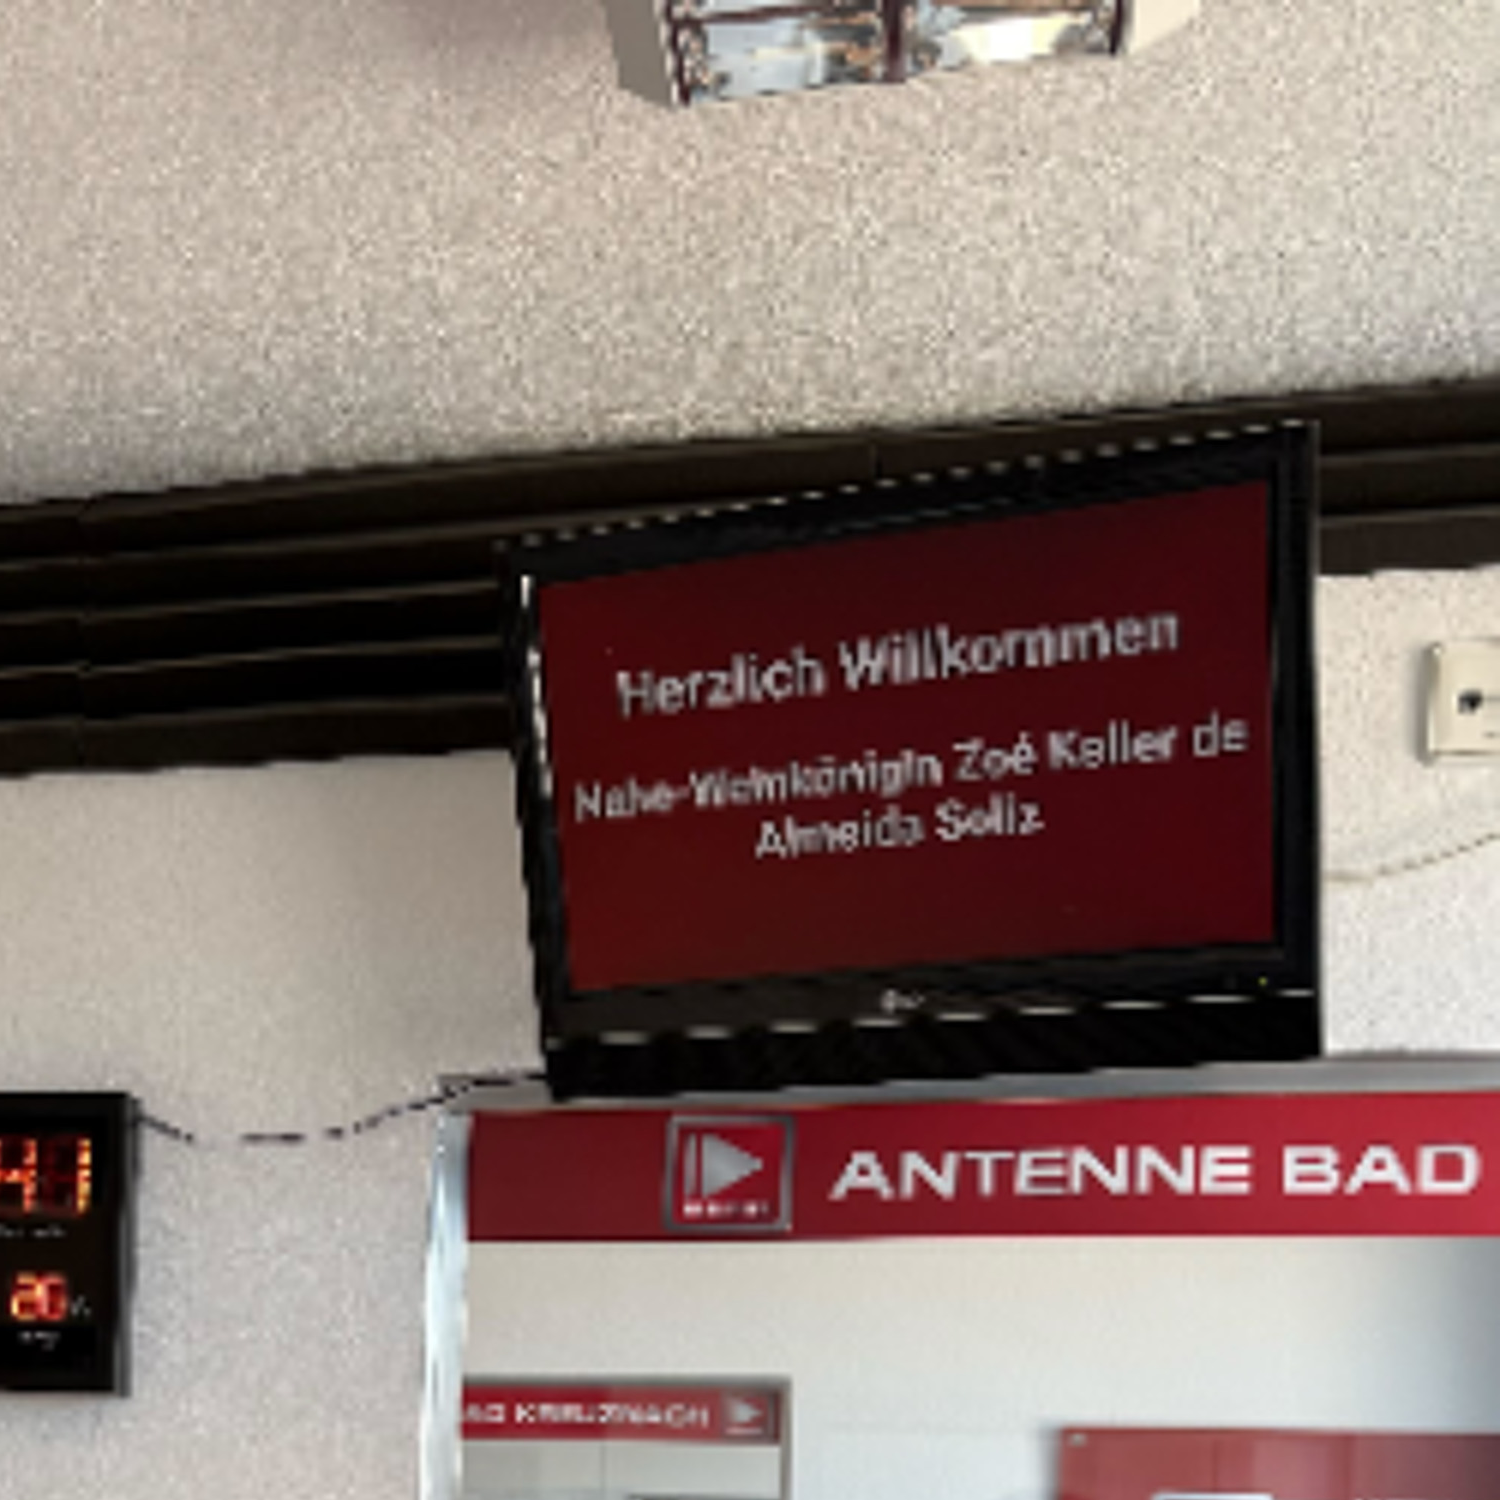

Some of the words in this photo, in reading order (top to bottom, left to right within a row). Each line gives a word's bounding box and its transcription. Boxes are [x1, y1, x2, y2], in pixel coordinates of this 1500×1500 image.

[615, 645, 826, 720] Herzlich
[838, 613, 1179, 692] Willkommen
[1049, 719, 1178, 770] Keller
[1192, 707, 1248, 758] de
[755, 803, 924, 859] Almeida
[828, 1145, 1252, 1202] ANTENNE
[1282, 1144, 1482, 1196] BAD
